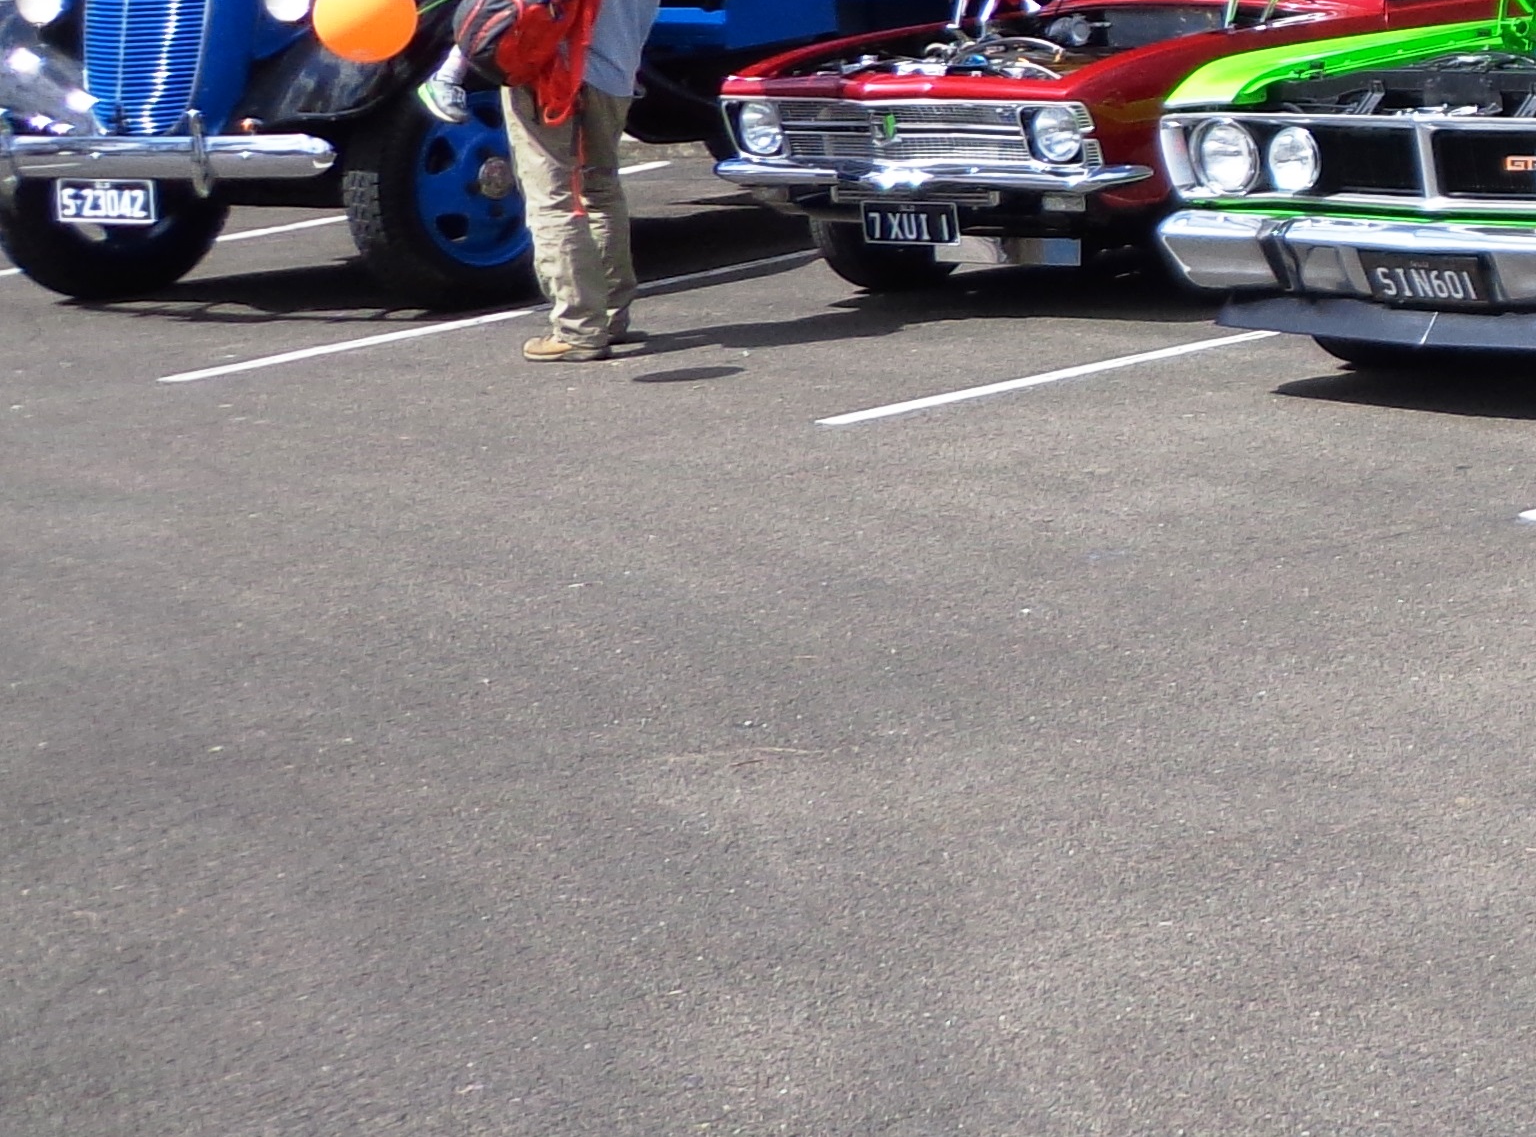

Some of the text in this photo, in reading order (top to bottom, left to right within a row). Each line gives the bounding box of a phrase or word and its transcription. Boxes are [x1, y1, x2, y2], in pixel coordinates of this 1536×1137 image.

[61, 188, 148, 218] S-23042
[868, 212, 881, 239] 7
[1376, 267, 1478, 300] SIN601
